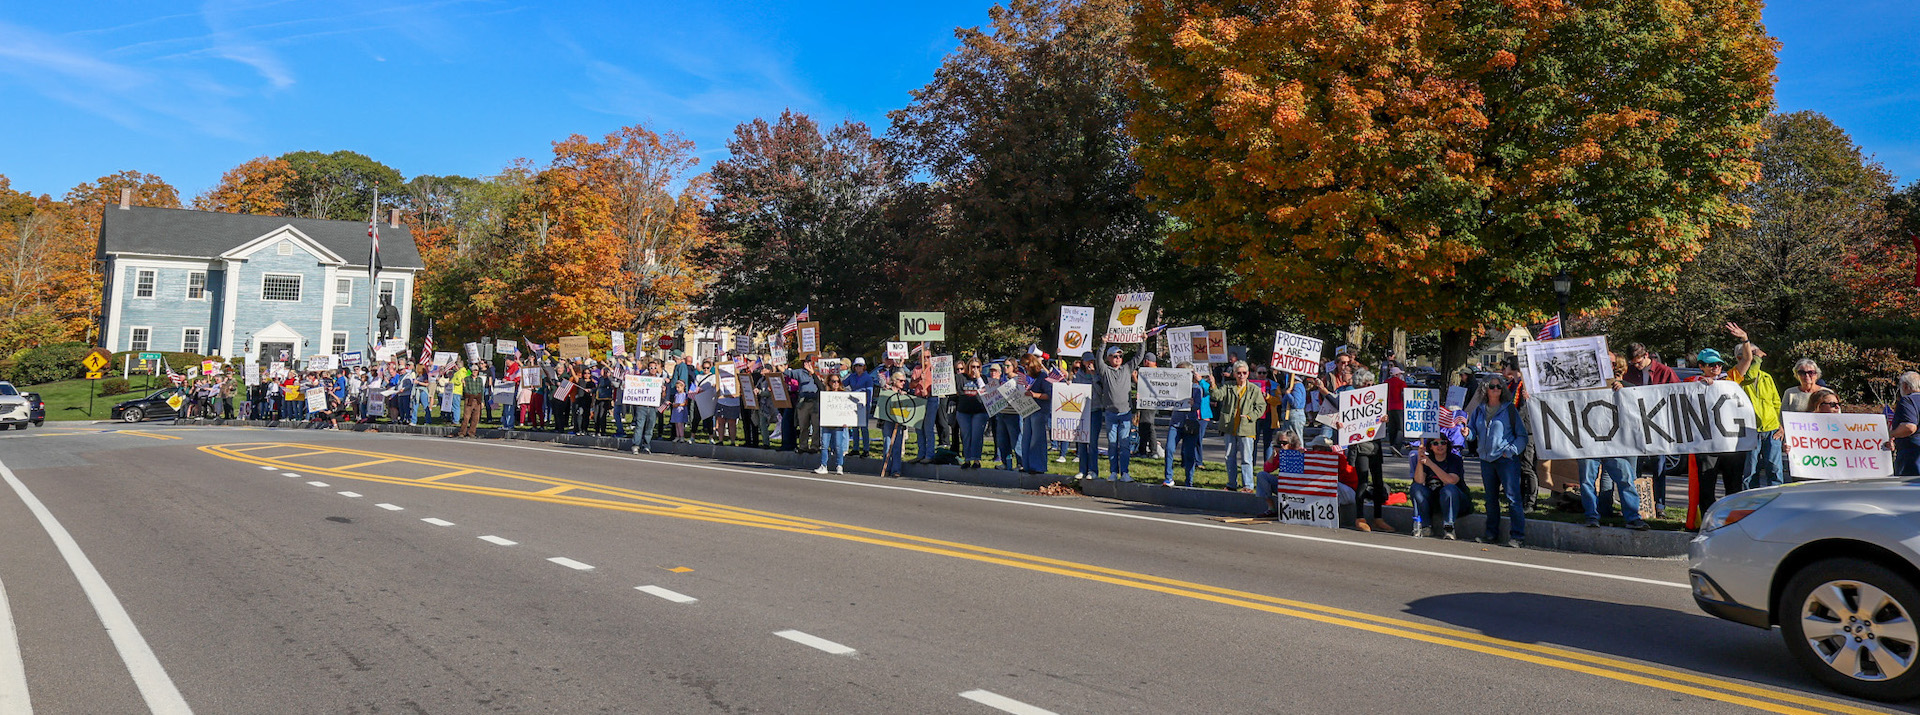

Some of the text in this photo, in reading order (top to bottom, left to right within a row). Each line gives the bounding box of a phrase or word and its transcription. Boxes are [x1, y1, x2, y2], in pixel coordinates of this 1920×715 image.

[1116, 292, 1153, 302] NO KINGS
[904, 318, 927, 335] NO
[1107, 333, 1142, 342] ENOUGH
[1277, 332, 1323, 353] PROTESTS
[889, 350, 907, 358] KINGS
[1286, 347, 1303, 357] ARE
[1271, 352, 1319, 376] PATRIOTIC
[820, 366, 840, 374] KINGS
[624, 395, 656, 403] IDENTITIES
[1350, 390, 1376, 407] NO
[1412, 389, 1433, 400] IKEA
[1142, 400, 1184, 408] DEMOCRACY
[1405, 400, 1439, 410] MAKES A
[1342, 402, 1383, 423] KINGS
[1407, 410, 1436, 421] BETTER
[1056, 418, 1085, 430] PROTECT
[1540, 393, 1747, 449] NO KING
[1789, 421, 1878, 432] THIS IS WHAT
[1344, 423, 1357, 433] YES
[1405, 422, 1438, 433] CABINET.
[1052, 428, 1089, 441] DEMOCRACY
[1791, 436, 1883, 450] DEMOCRACY
[1846, 456, 1879, 469] LIKE
[1281, 494, 1306, 503] Jimmy
